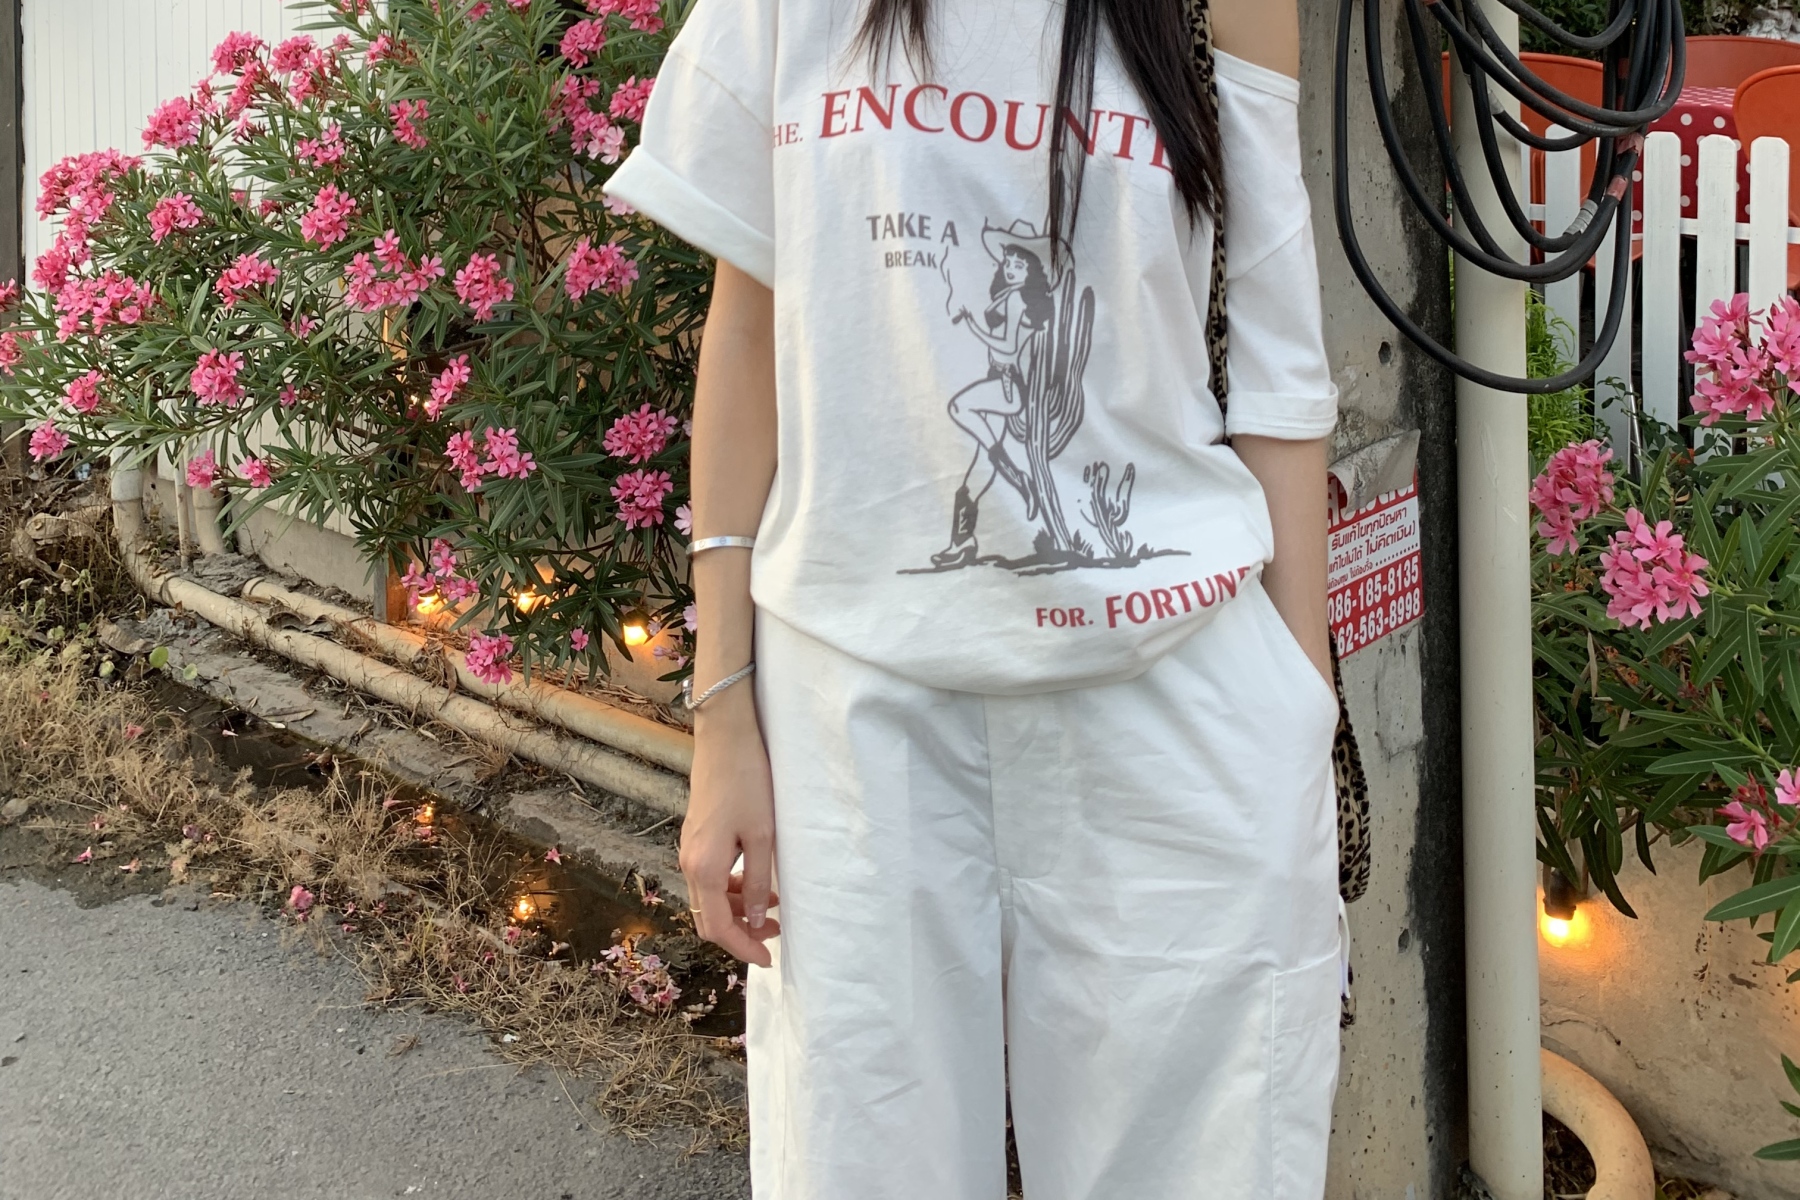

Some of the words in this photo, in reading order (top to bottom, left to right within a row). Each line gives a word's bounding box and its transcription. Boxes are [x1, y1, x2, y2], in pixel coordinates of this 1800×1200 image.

[866, 211, 932, 241] TAKE
[940, 220, 960, 247] A
[884, 249, 938, 270] BREAK
[1328, 555, 1419, 626] 086-185-8135
[1035, 607, 1094, 628] FOR.
[1333, 587, 1421, 657] 62-563-8998
